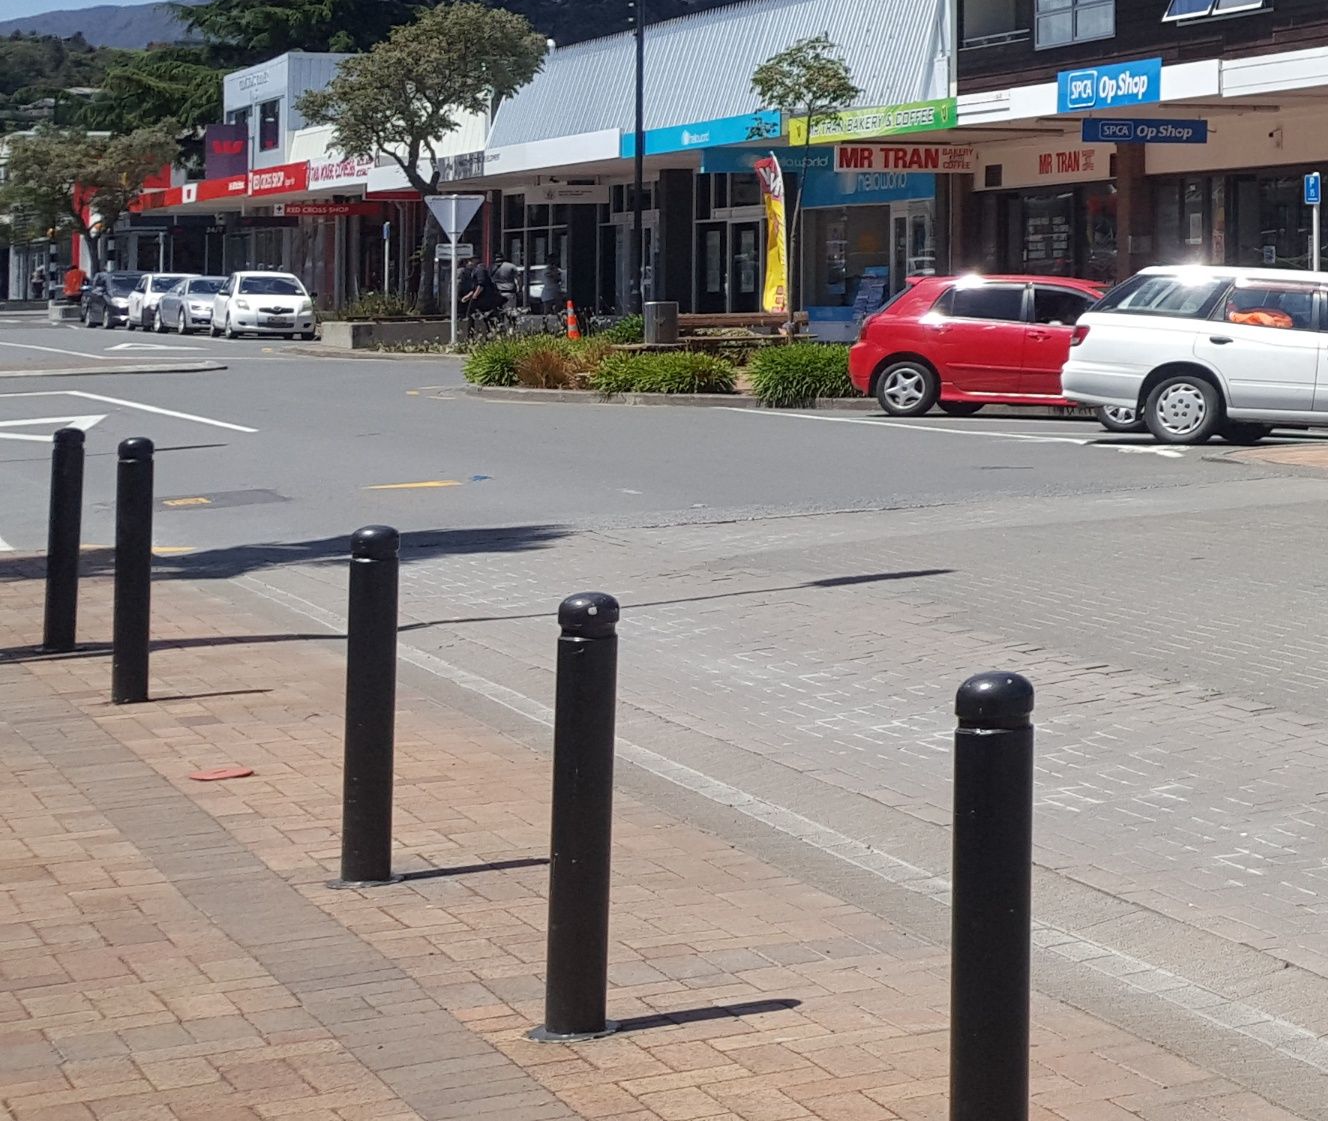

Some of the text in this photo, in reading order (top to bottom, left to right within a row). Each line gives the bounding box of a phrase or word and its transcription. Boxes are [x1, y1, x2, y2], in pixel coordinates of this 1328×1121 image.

[1071, 70, 1148, 104] SPCA Op Shop
[847, 114, 883, 133] BAKERY
[895, 107, 934, 127] COFFEE
[1103, 124, 1193, 140] SPCA Op Shop
[839, 147, 940, 169] MR TRAN
[942, 147, 974, 157] BAKERY
[942, 161, 971, 170] COFFEE
[1039, 150, 1080, 175] MR TRAN
[286, 206, 300, 214] RED
[303, 206, 328, 214] CROSS
